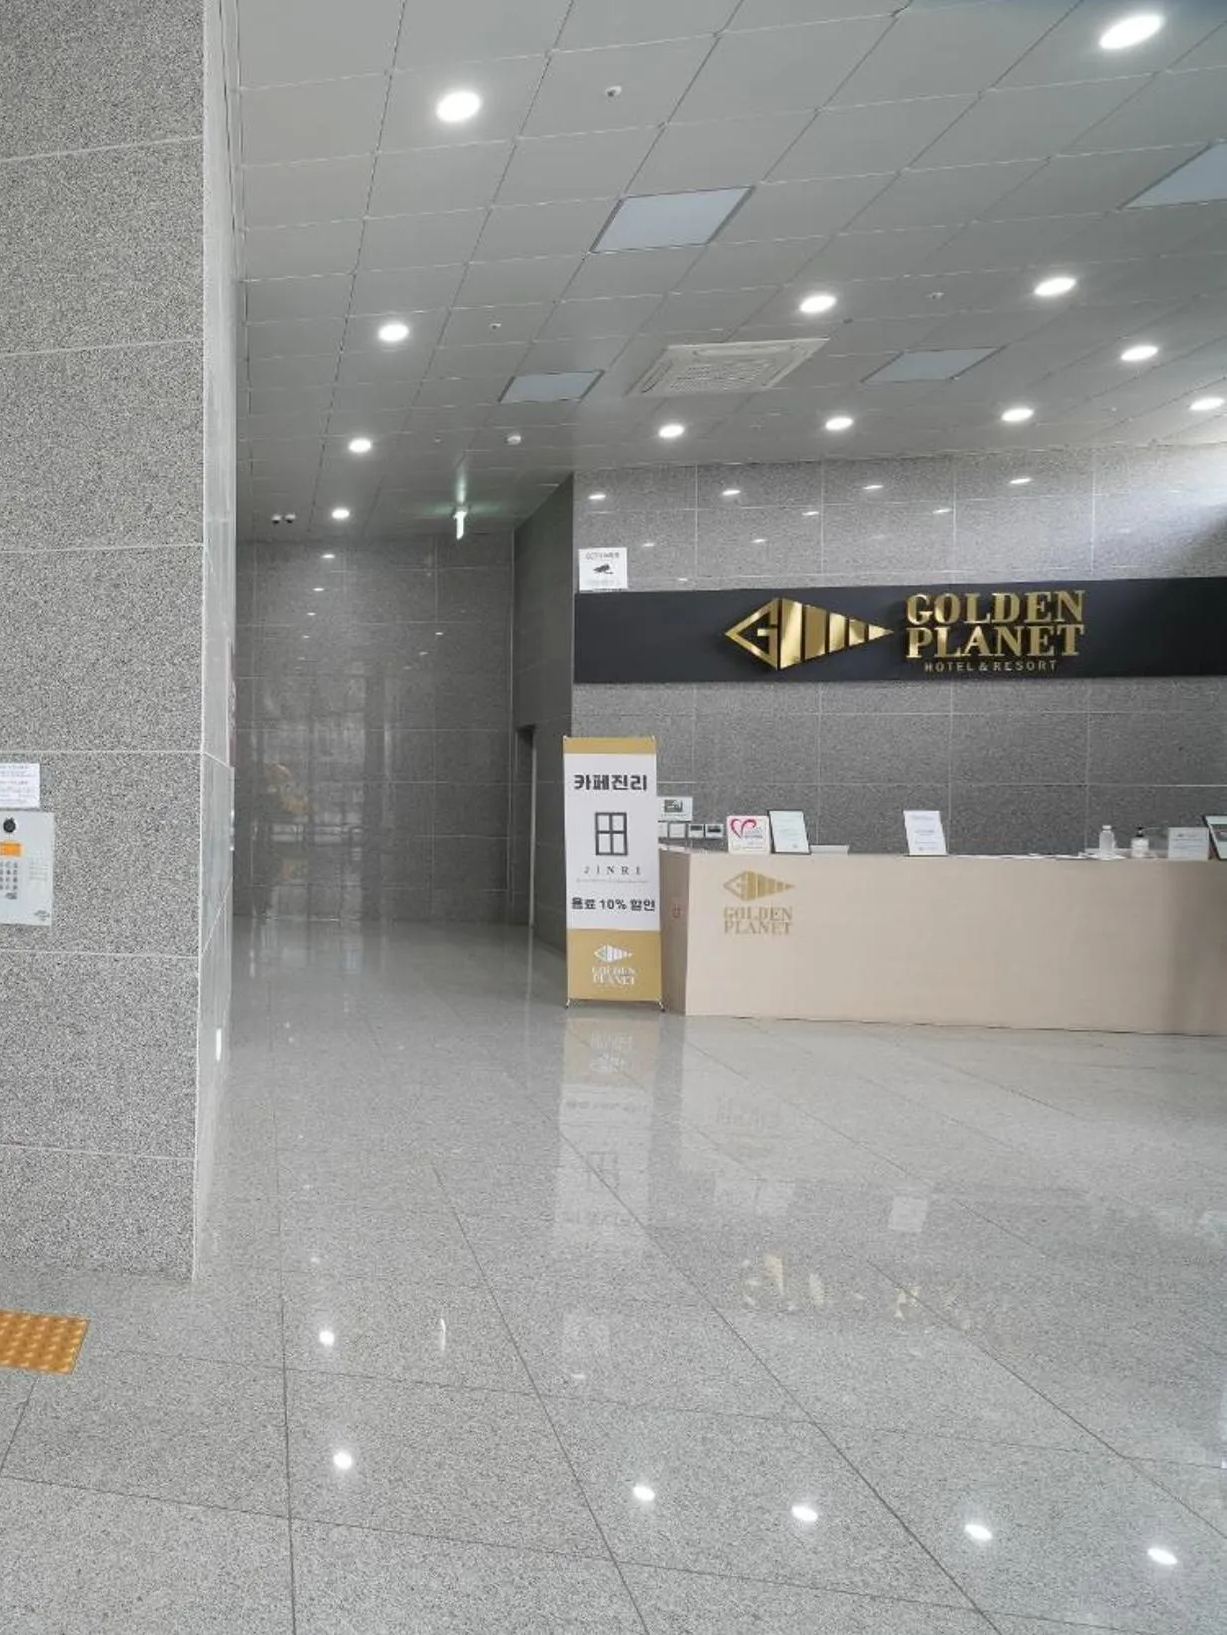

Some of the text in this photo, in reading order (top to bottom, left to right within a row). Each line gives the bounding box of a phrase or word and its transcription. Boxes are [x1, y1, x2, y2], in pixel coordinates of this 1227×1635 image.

[905, 589, 1085, 626] GOLDEN
[906, 624, 1085, 659] PLANET
[925, 659, 1057, 673] HOTEL & RESORT
[573, 774, 647, 791] 카페진리
[571, 897, 655, 912] 음료 10% 할인
[723, 906, 793, 920] GOLDEN
[724, 921, 792, 934] PLANET
